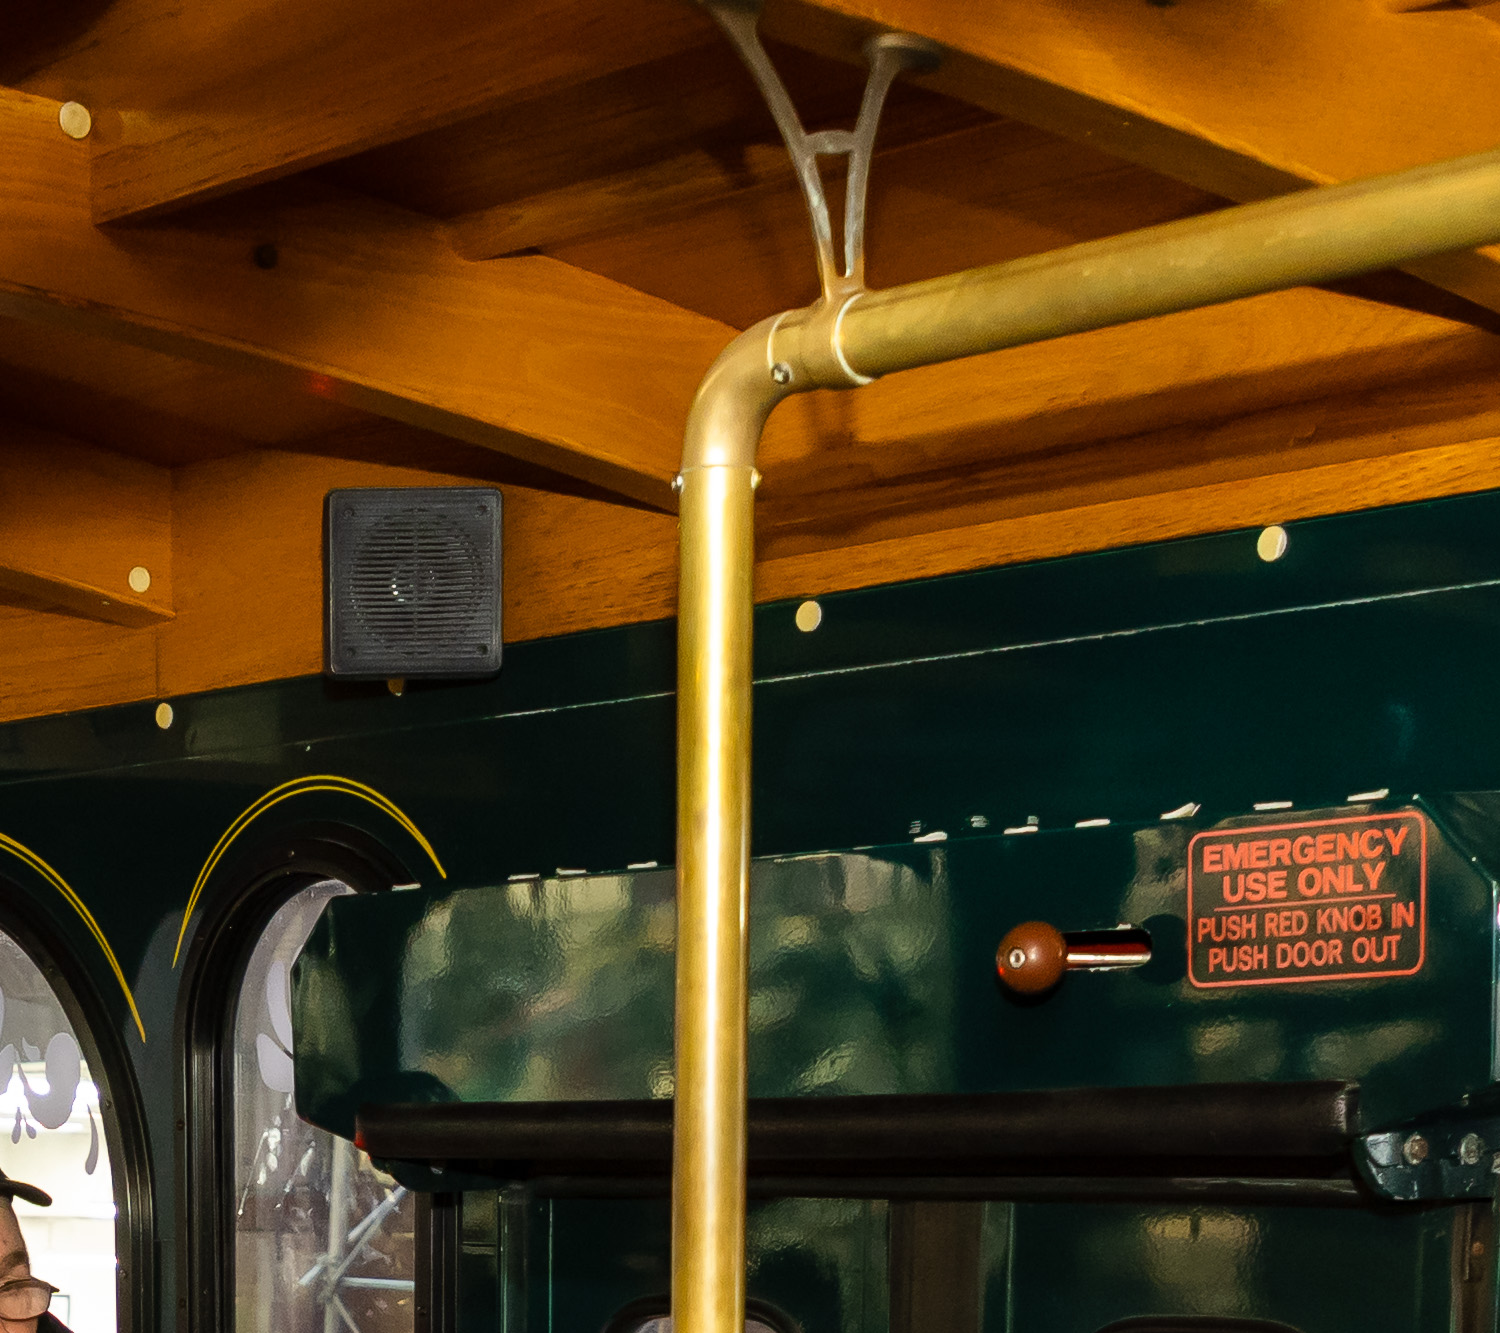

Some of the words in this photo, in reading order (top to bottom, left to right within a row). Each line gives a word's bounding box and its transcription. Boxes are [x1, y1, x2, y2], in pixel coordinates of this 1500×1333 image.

[1202, 826, 1409, 874] EMERGENCY
[1222, 870, 1288, 904] USE
[1297, 861, 1387, 897] ONLY
[1197, 915, 1257, 943] PUSH
[1264, 910, 1309, 938] RED
[1316, 904, 1382, 934] KNOB
[1391, 901, 1415, 929] IN
[1208, 945, 1268, 974] PUSH
[1276, 939, 1344, 969] DOOR
[1352, 935, 1402, 964] OUT
